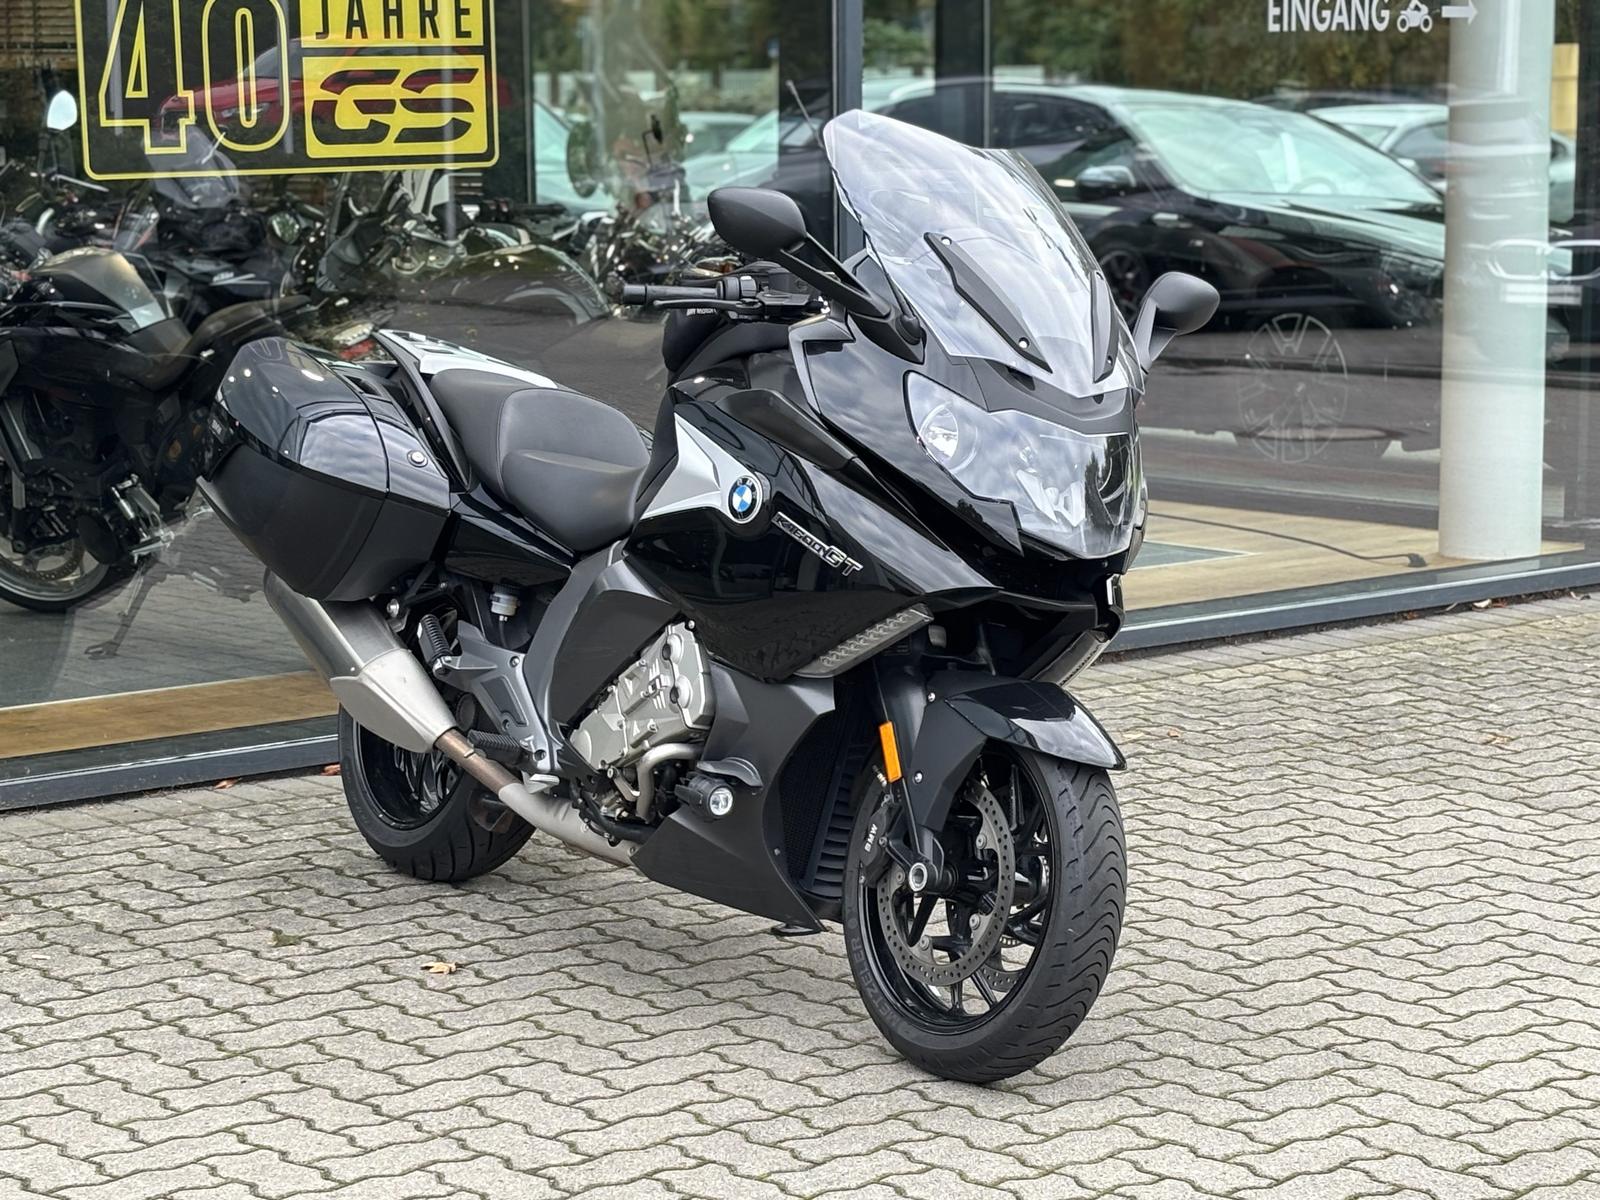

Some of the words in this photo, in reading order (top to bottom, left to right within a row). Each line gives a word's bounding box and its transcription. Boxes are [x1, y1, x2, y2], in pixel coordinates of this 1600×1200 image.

[315, 0, 472, 39] JAHRE
[1268, 0, 1390, 32] EINGANG
[98, 0, 290, 155] 40
[311, 68, 479, 145] GS
[864, 823, 878, 852] BMW
[851, 936, 900, 1027] METZELER
